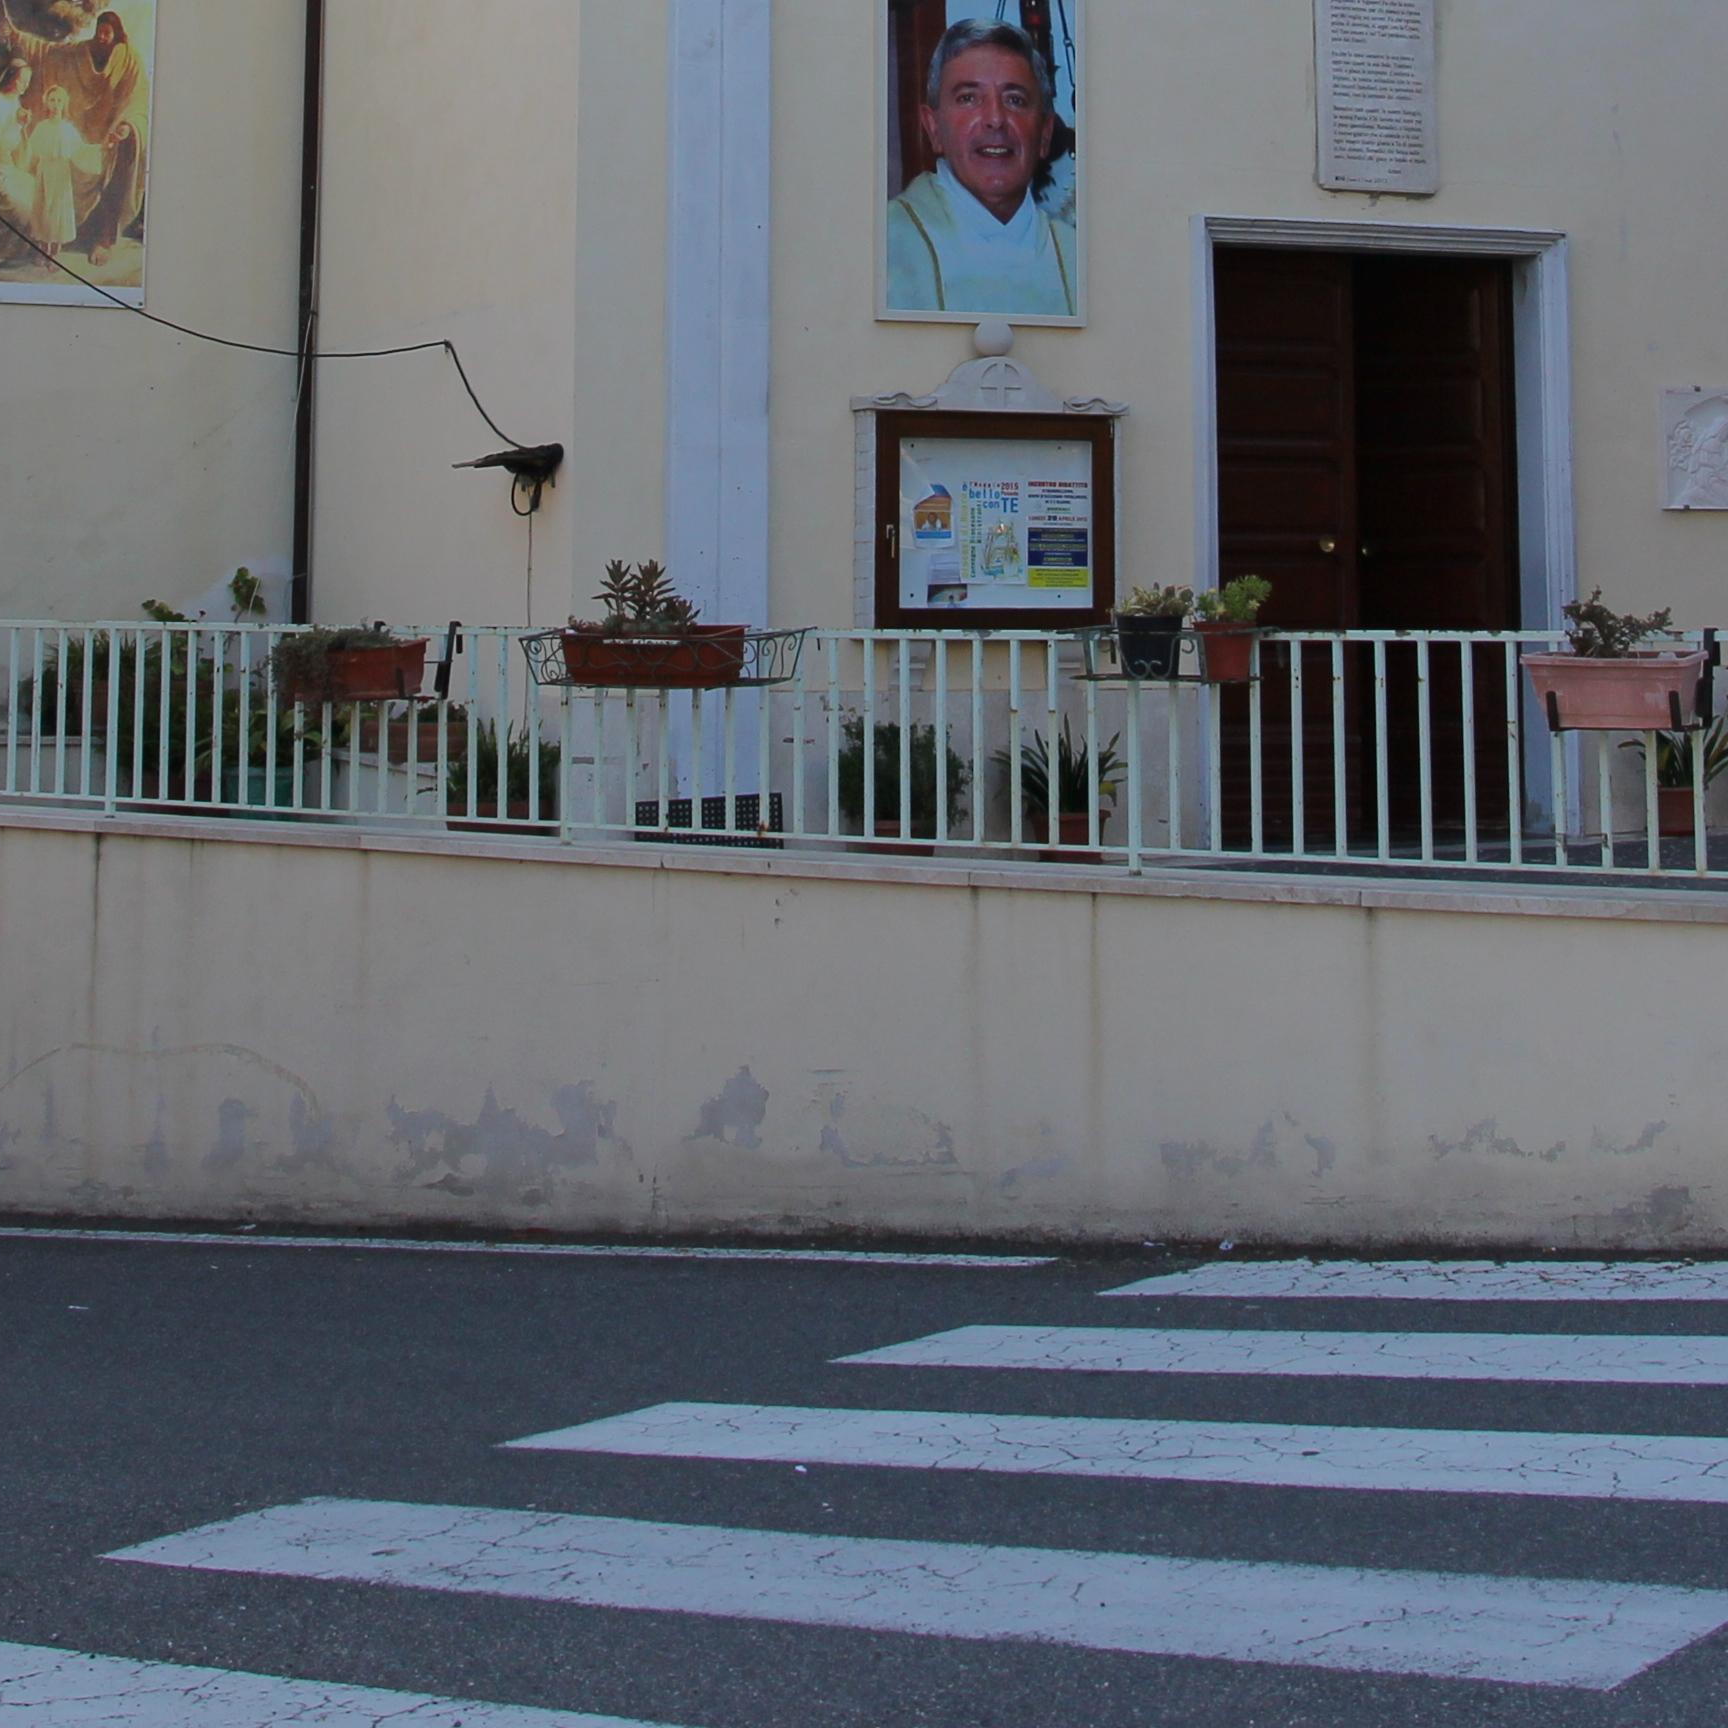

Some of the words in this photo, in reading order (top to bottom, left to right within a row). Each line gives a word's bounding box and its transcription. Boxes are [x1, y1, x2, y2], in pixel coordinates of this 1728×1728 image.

[969, 488, 1000, 499] bello
[982, 500, 1000, 509] con
[1000, 497, 1019, 513] TE
